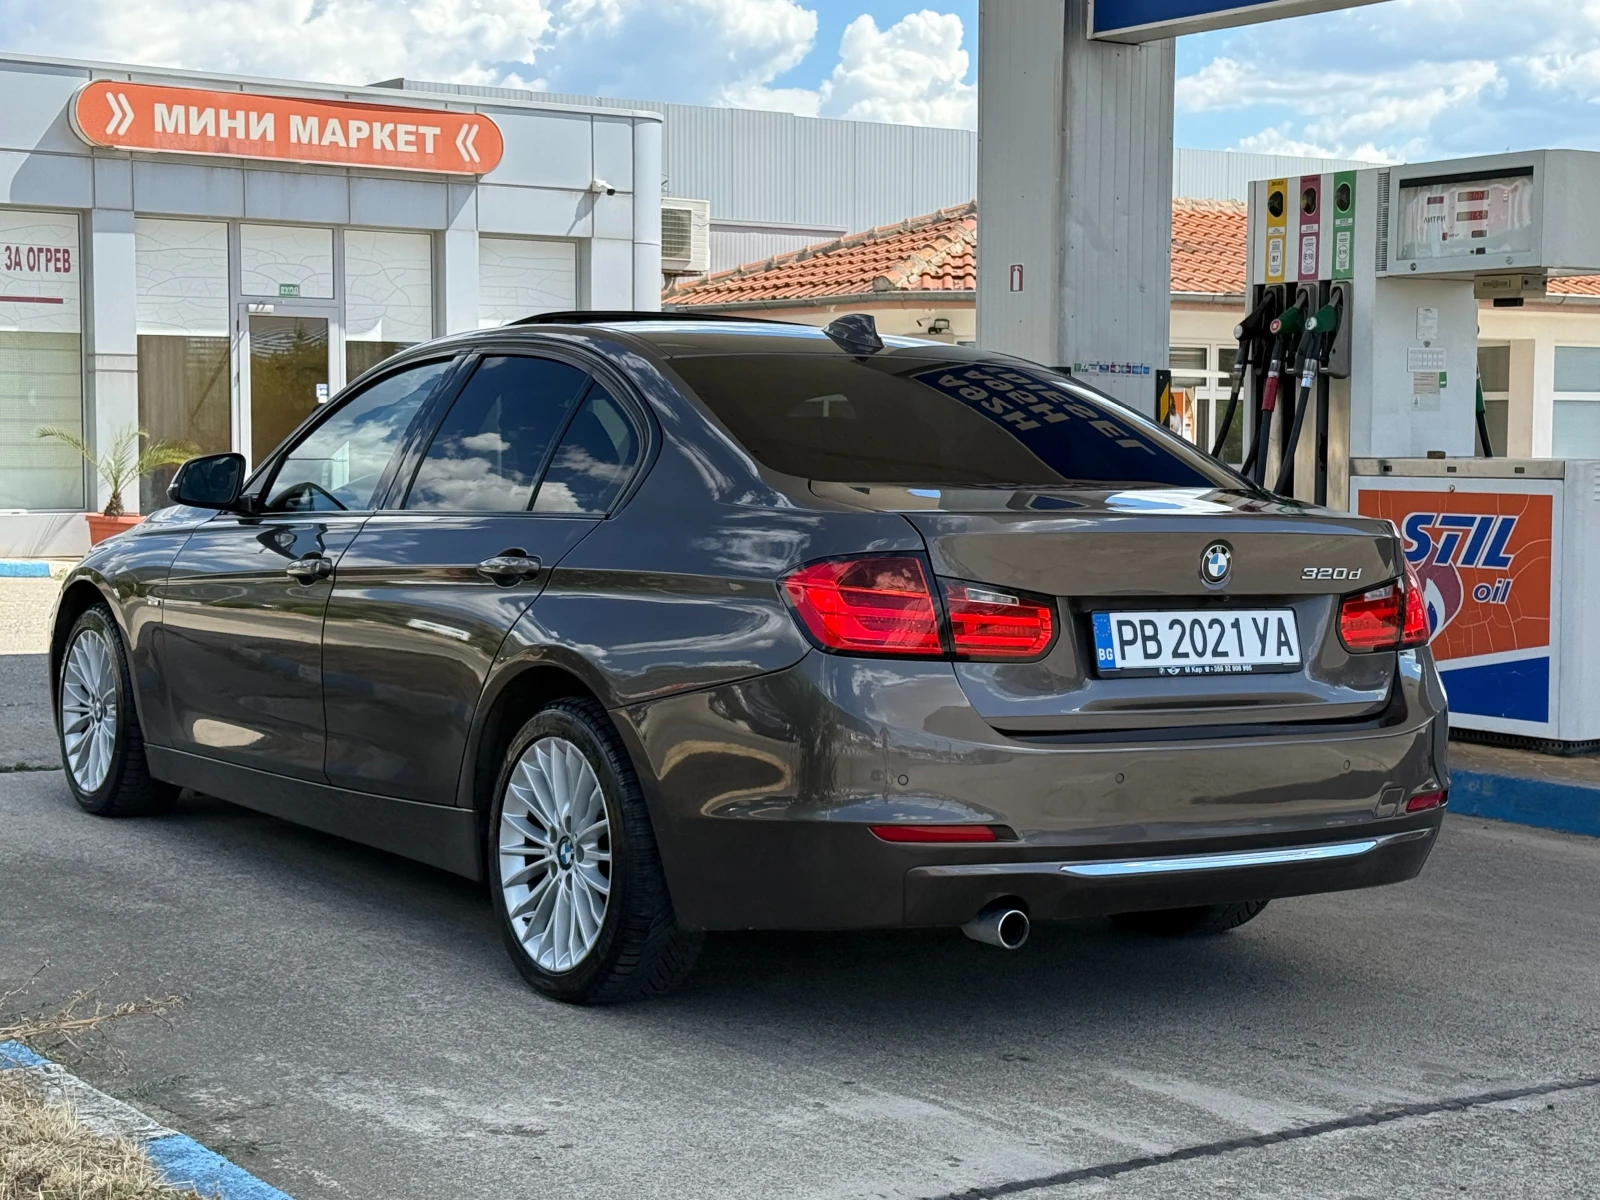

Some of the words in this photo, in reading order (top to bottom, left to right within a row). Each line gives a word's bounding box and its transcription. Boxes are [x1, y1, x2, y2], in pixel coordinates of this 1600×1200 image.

[154, 103, 275, 142] МИНИ
[289, 116, 441, 154] МАРКЕТ
[1424, 215, 1446, 224] ЛИТРИ
[5, 245, 23, 271] ЗА
[27, 246, 71, 273] ОГРЕВ
[280, 285, 299, 296] ВХОД
[1403, 512, 1519, 570] STIL
[1301, 567, 1362, 581] 320d
[1472, 578, 1513, 605] oil
[1116, 619, 1162, 661] PB
[1168, 617, 1245, 659] 2021
[1251, 616, 1294, 657] YA
[1099, 648, 1113, 661] BG
